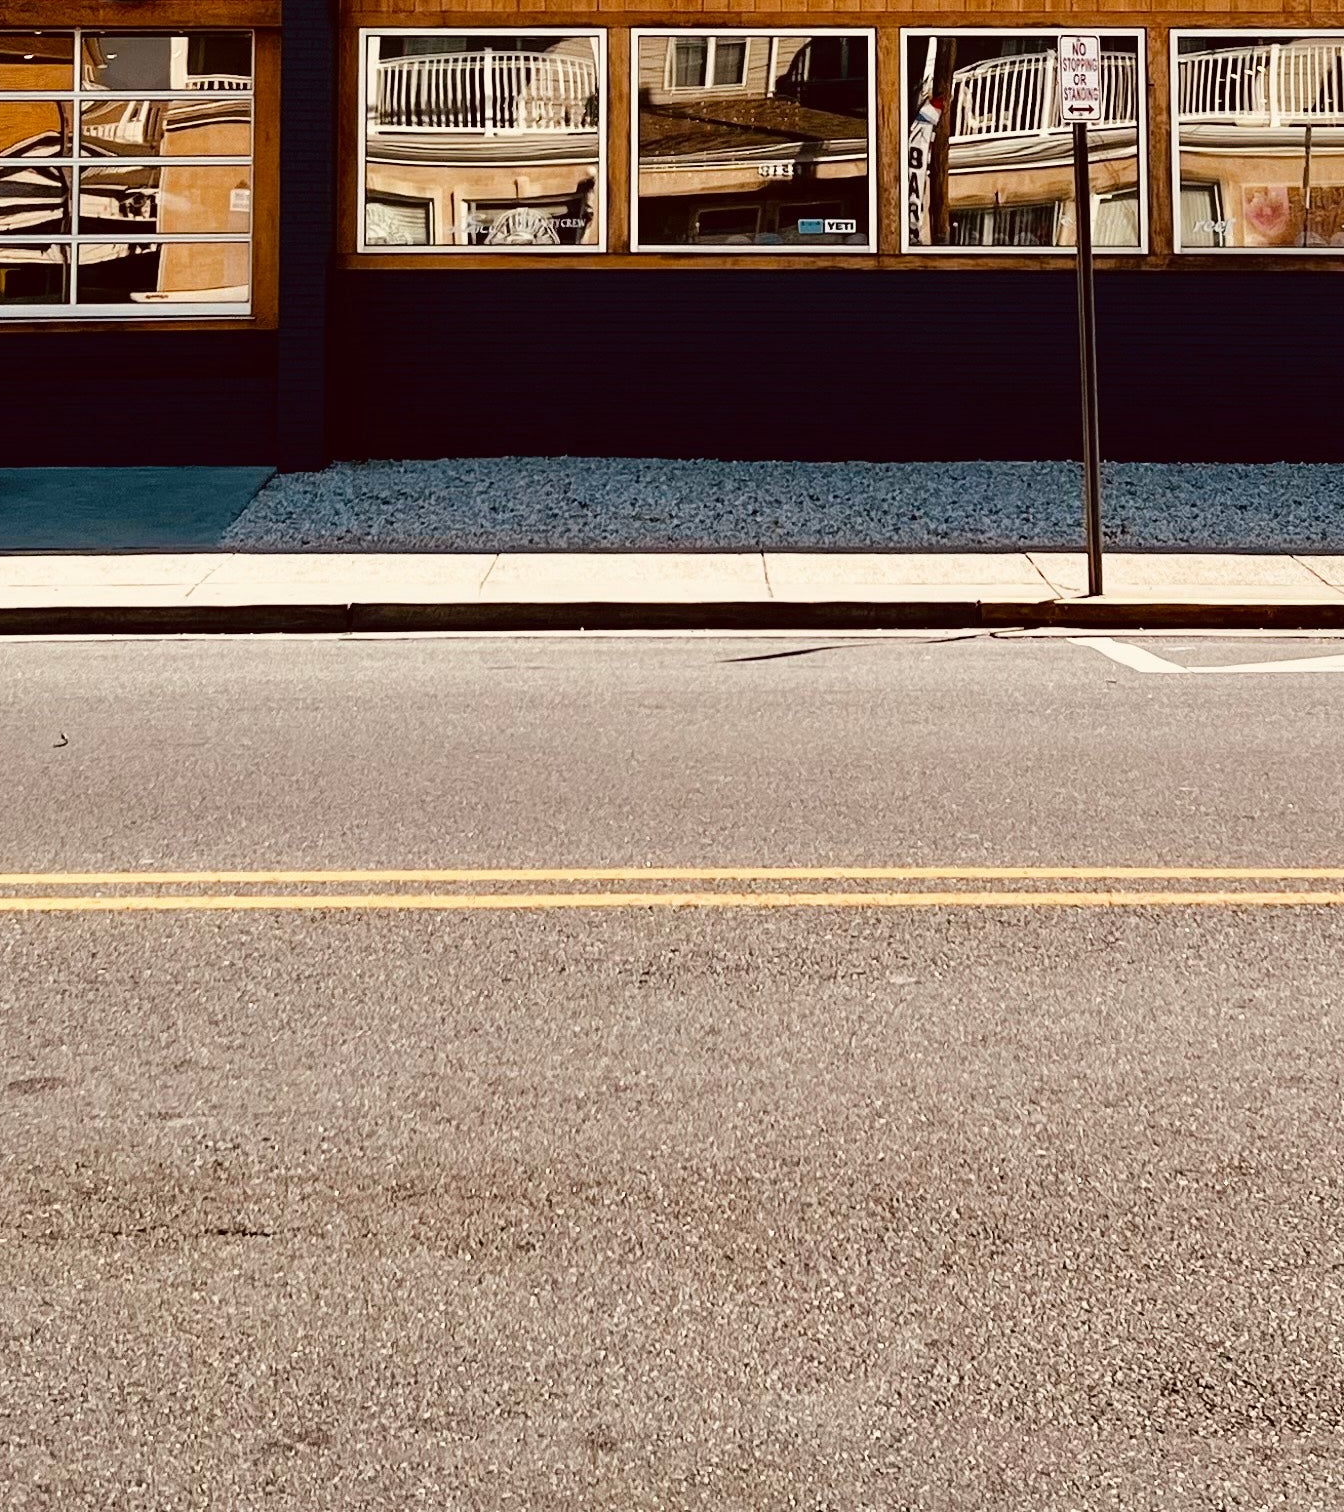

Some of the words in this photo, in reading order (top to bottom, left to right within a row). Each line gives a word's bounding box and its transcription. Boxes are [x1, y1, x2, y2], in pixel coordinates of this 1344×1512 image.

[1072, 42, 1087, 57] NO
[1063, 57, 1098, 72] STOPPING
[1073, 73, 1087, 86] OR
[1063, 86, 1099, 101] STANDING
[827, 221, 854, 231] YETI
